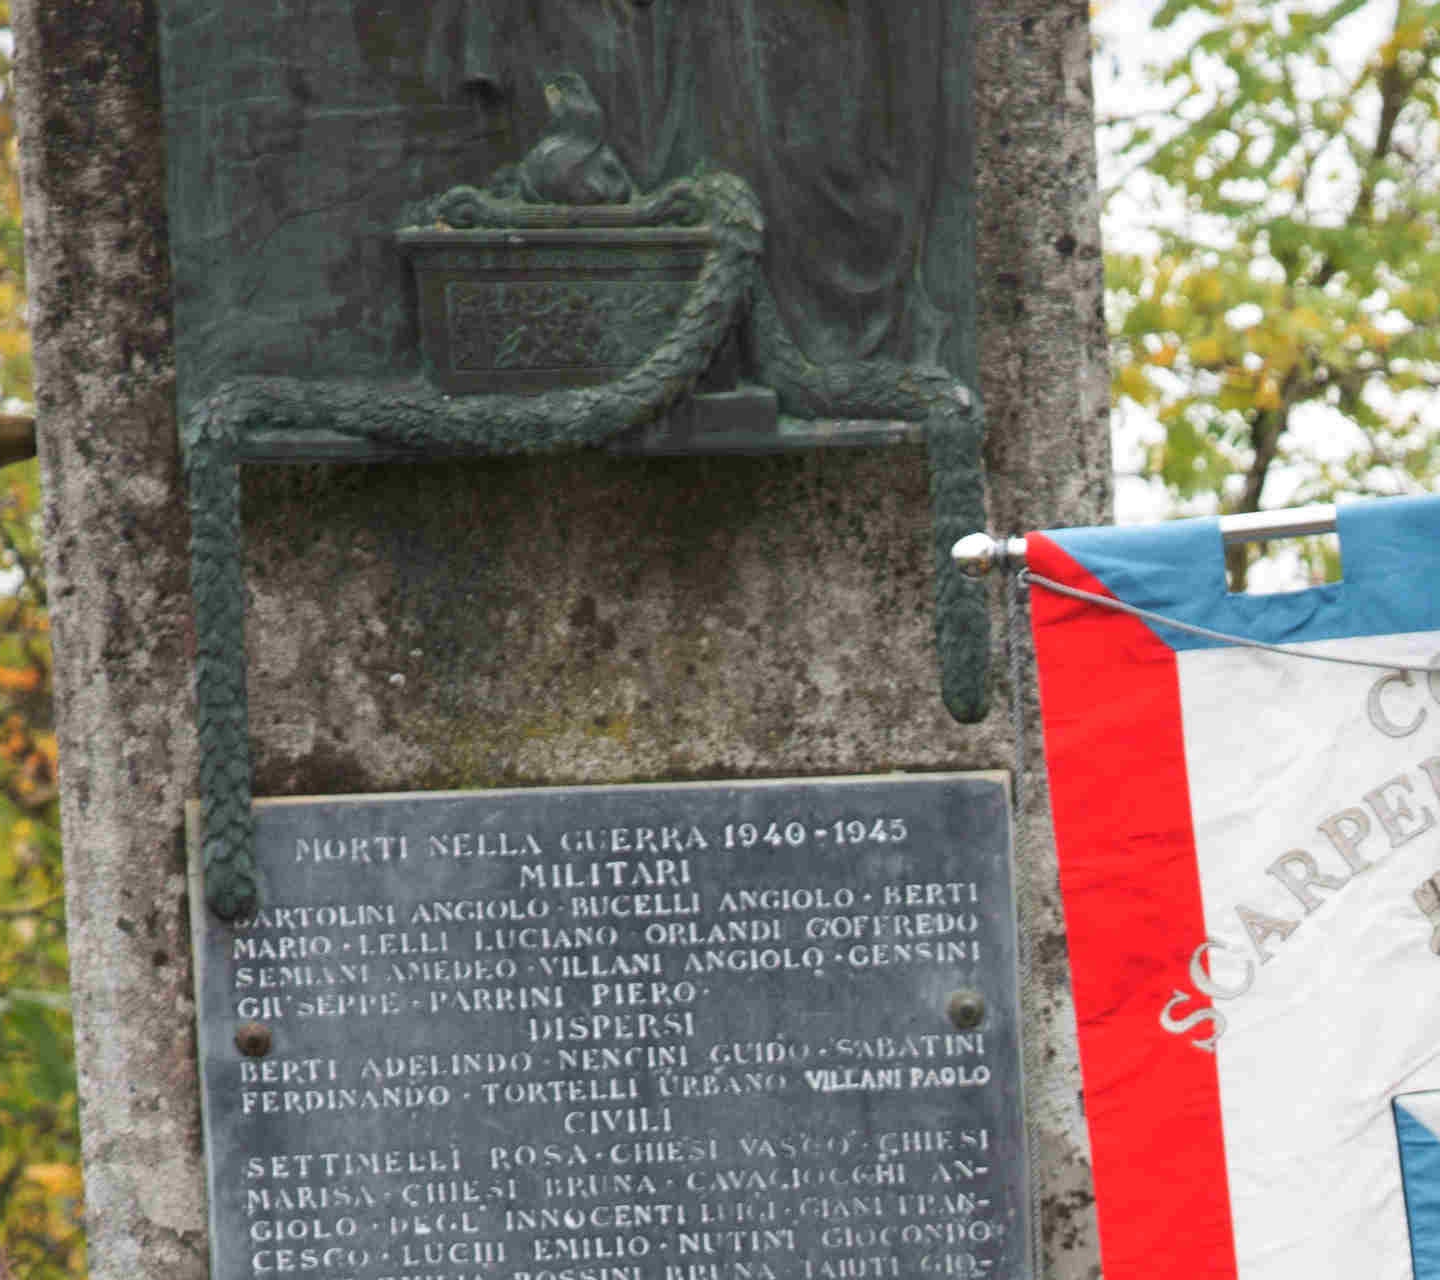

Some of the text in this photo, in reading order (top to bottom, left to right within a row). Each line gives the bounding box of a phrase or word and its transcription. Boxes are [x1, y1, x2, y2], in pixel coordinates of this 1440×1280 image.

[296, 818, 907, 863] MORTI NELLA GUERRA 1940-1945
[519, 859, 692, 888] MILITARI
[410, 897, 550, 923] ANGIOLO
[571, 893, 700, 919] BUCELLI
[718, 887, 855, 912] ANGIOLO
[883, 882, 978, 906] BERTI
[233, 913, 979, 960] MARIO LELLI LUCIANO ORLANDI GOFFREDO
[385, 958, 517, 983] AMEDEO
[539, 953, 662, 979] VILLANI
[683, 947, 825, 974] ANGIOLO
[236, 982, 696, 1020] GIUSEPPE PARRINI PIERO
[528, 1012, 696, 1042] DISPERSI
[240, 1034, 985, 1084] BERTI ADELINDO NENCINI GUIDO SABATINI
[242, 1065, 991, 1114] FERDINANDO TORTELLI URBANO VILLANI PAOLO
[564, 1107, 673, 1135] CIVILI
[246, 1150, 461, 1179] SETTIMELLI
[489, 1144, 589, 1170] ROSA
[609, 1138, 718, 1165] CHIESI
[879, 1129, 989, 1157] CHIESI
[246, 1186, 376, 1214] MARISA
[401, 1179, 518, 1207] CHIESI
[545, 1173, 657, 1199] BRUNA
[249, 1217, 358, 1242] GIOLO
[506, 1202, 686, 1231] INNOCENTI
[252, 1247, 369, 1272] CESCO
[534, 1235, 651, 1262] EMILIO
[678, 1229, 796, 1255] NUTINI
[821, 1220, 993, 1248] GIOCONDO
